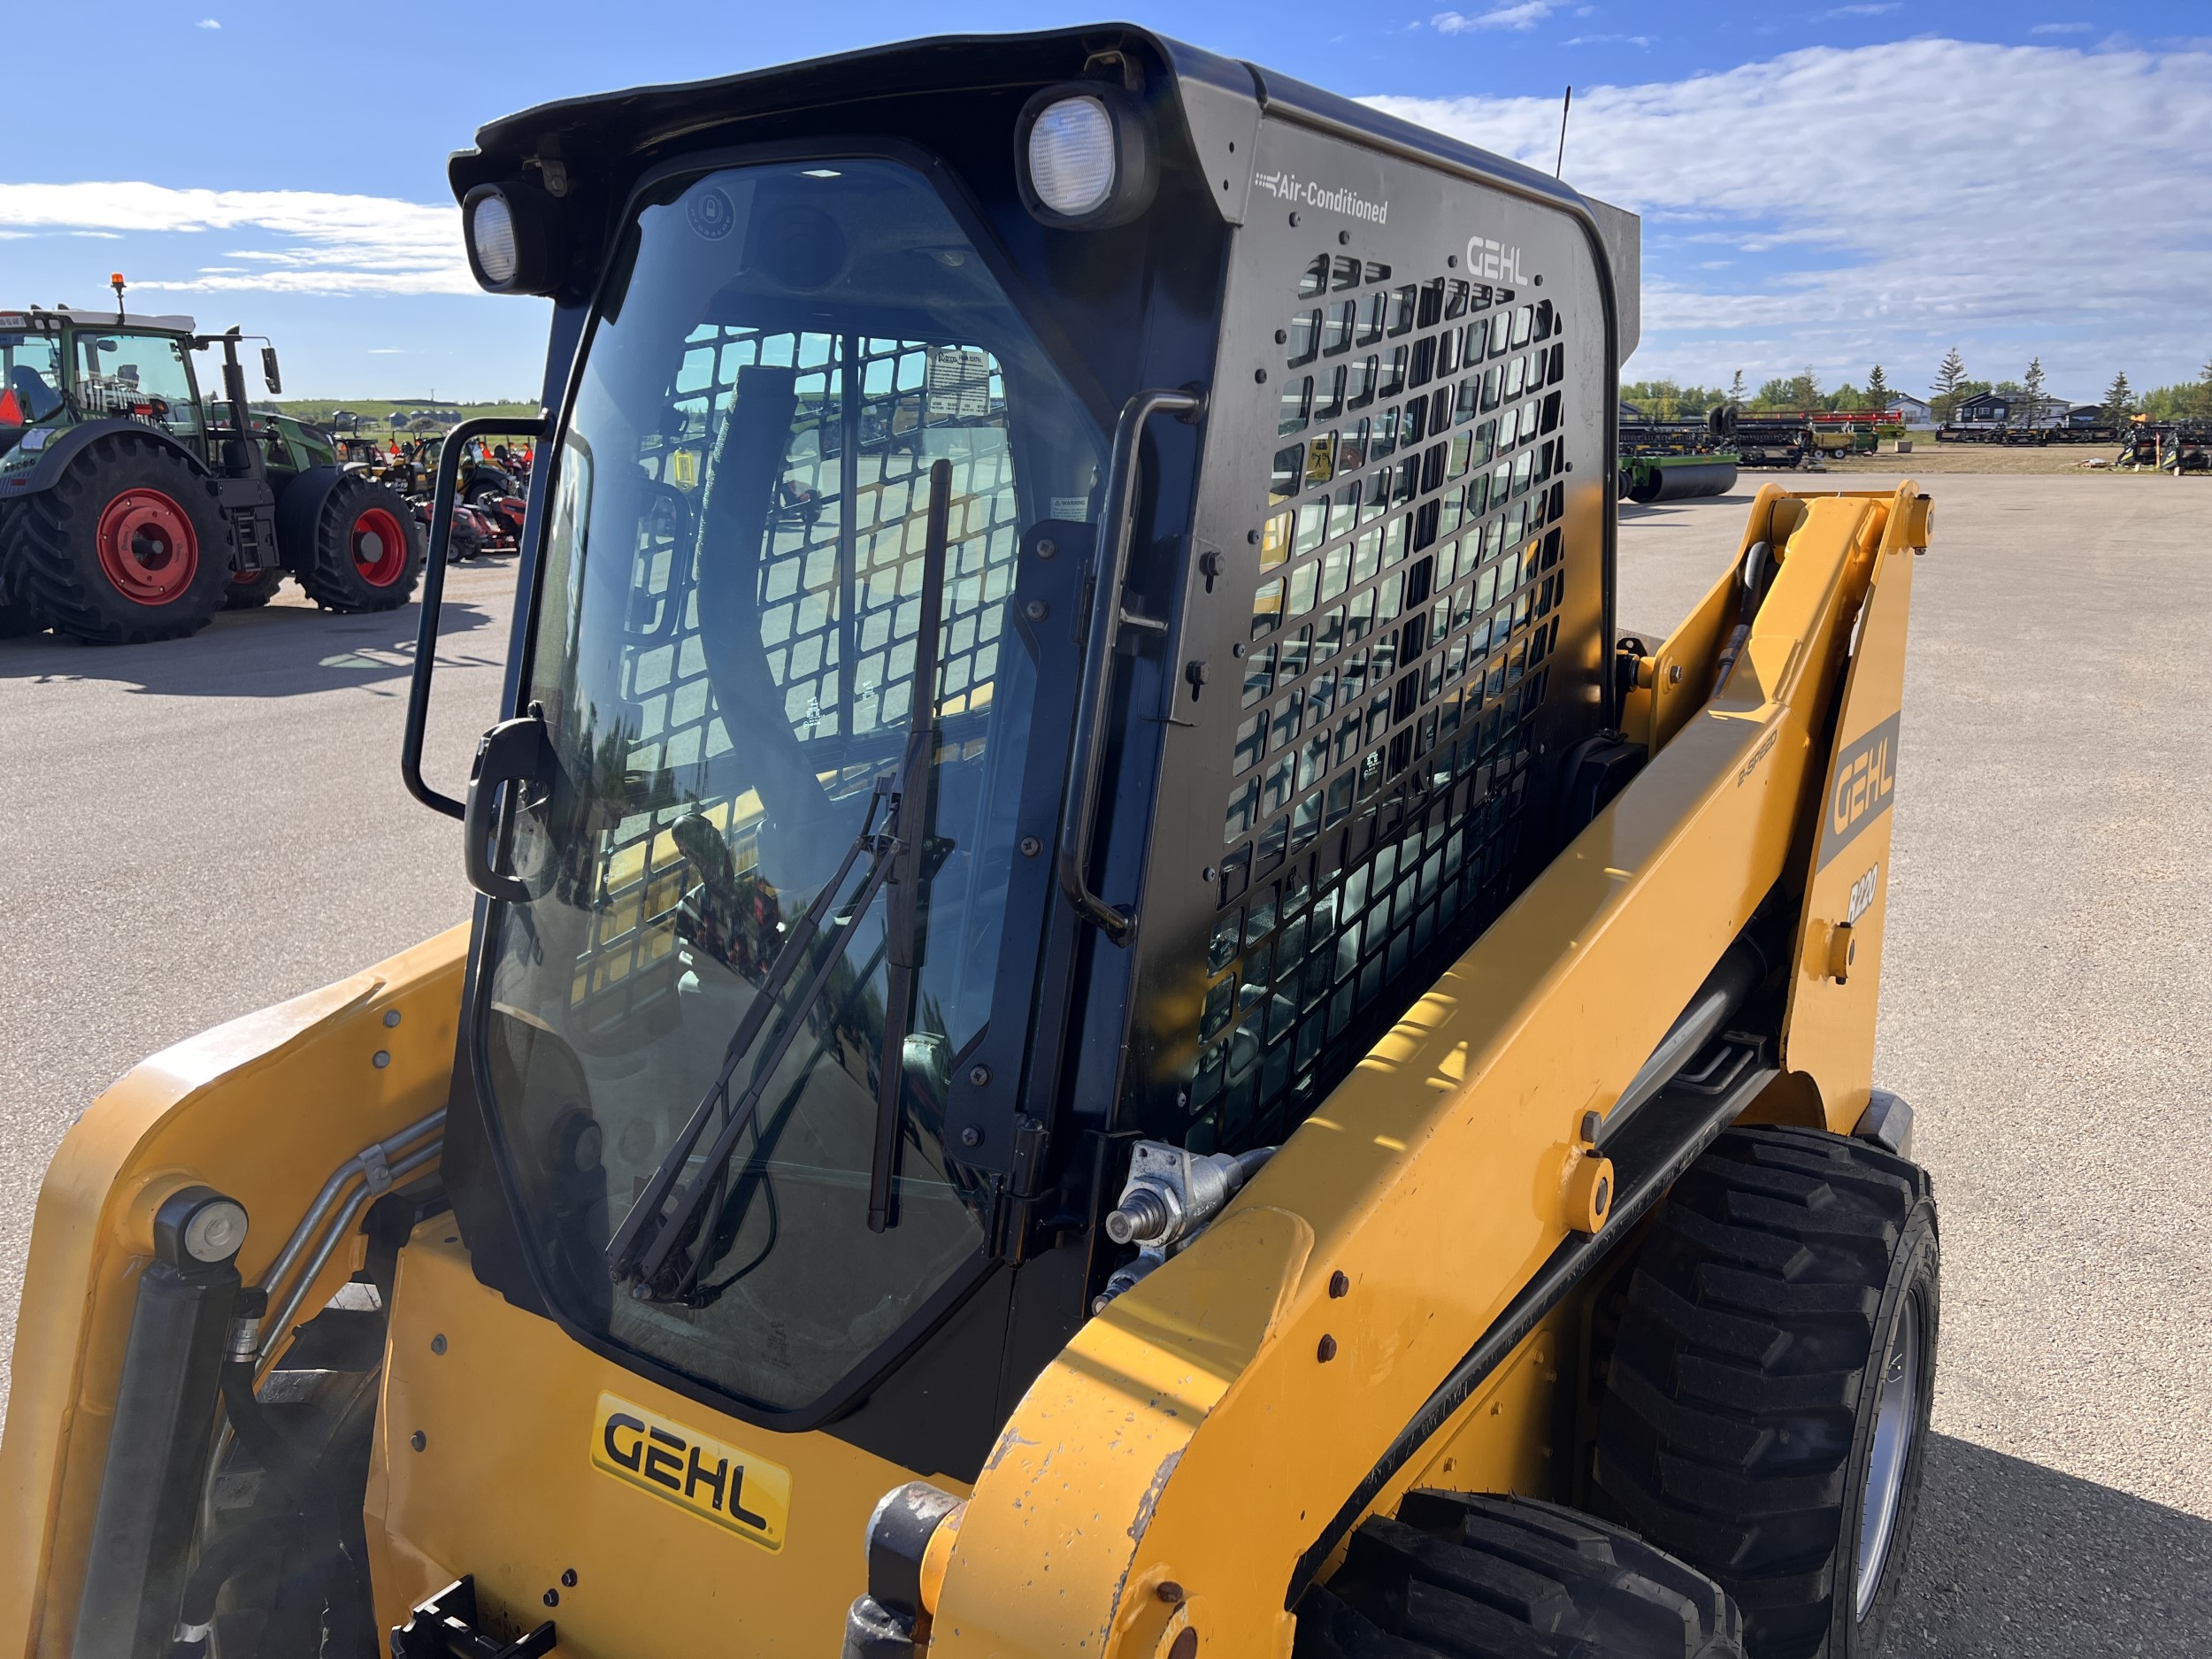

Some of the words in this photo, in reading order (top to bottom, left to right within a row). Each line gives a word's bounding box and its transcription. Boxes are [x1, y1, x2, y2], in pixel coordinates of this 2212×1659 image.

[1278, 173, 1388, 225] Air-Conditioned
[1466, 235, 1528, 286] GEHL
[1737, 729, 1778, 788] 2-SPEED
[1833, 736, 1893, 835] GEHL
[1847, 861, 1878, 926] R220
[603, 1412, 767, 1531] GEHL
